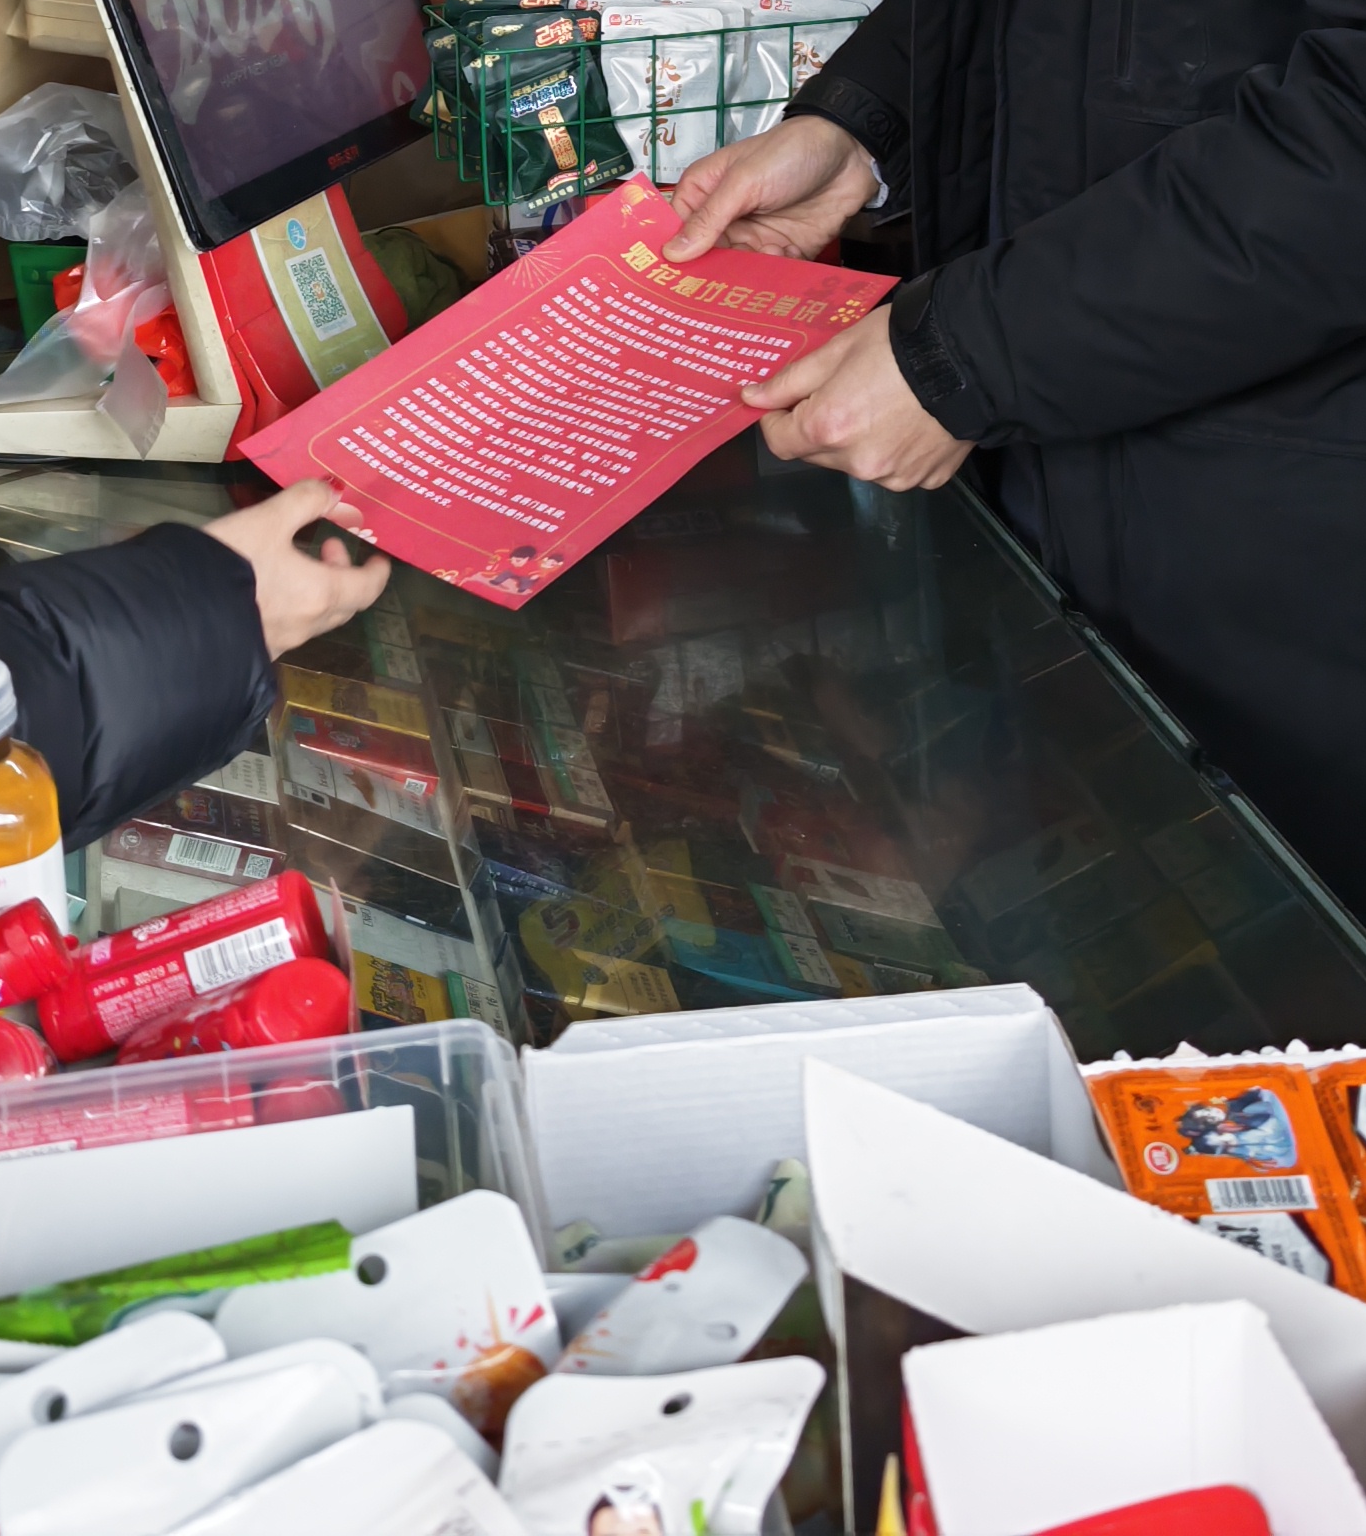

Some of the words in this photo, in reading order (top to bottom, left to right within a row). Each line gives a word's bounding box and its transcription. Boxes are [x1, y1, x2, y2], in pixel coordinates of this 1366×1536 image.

[775, 0, 793, 12] 2元
[624, 15, 643, 26] 2元
[617, 240, 830, 323] 烟花爆竹安全常识
